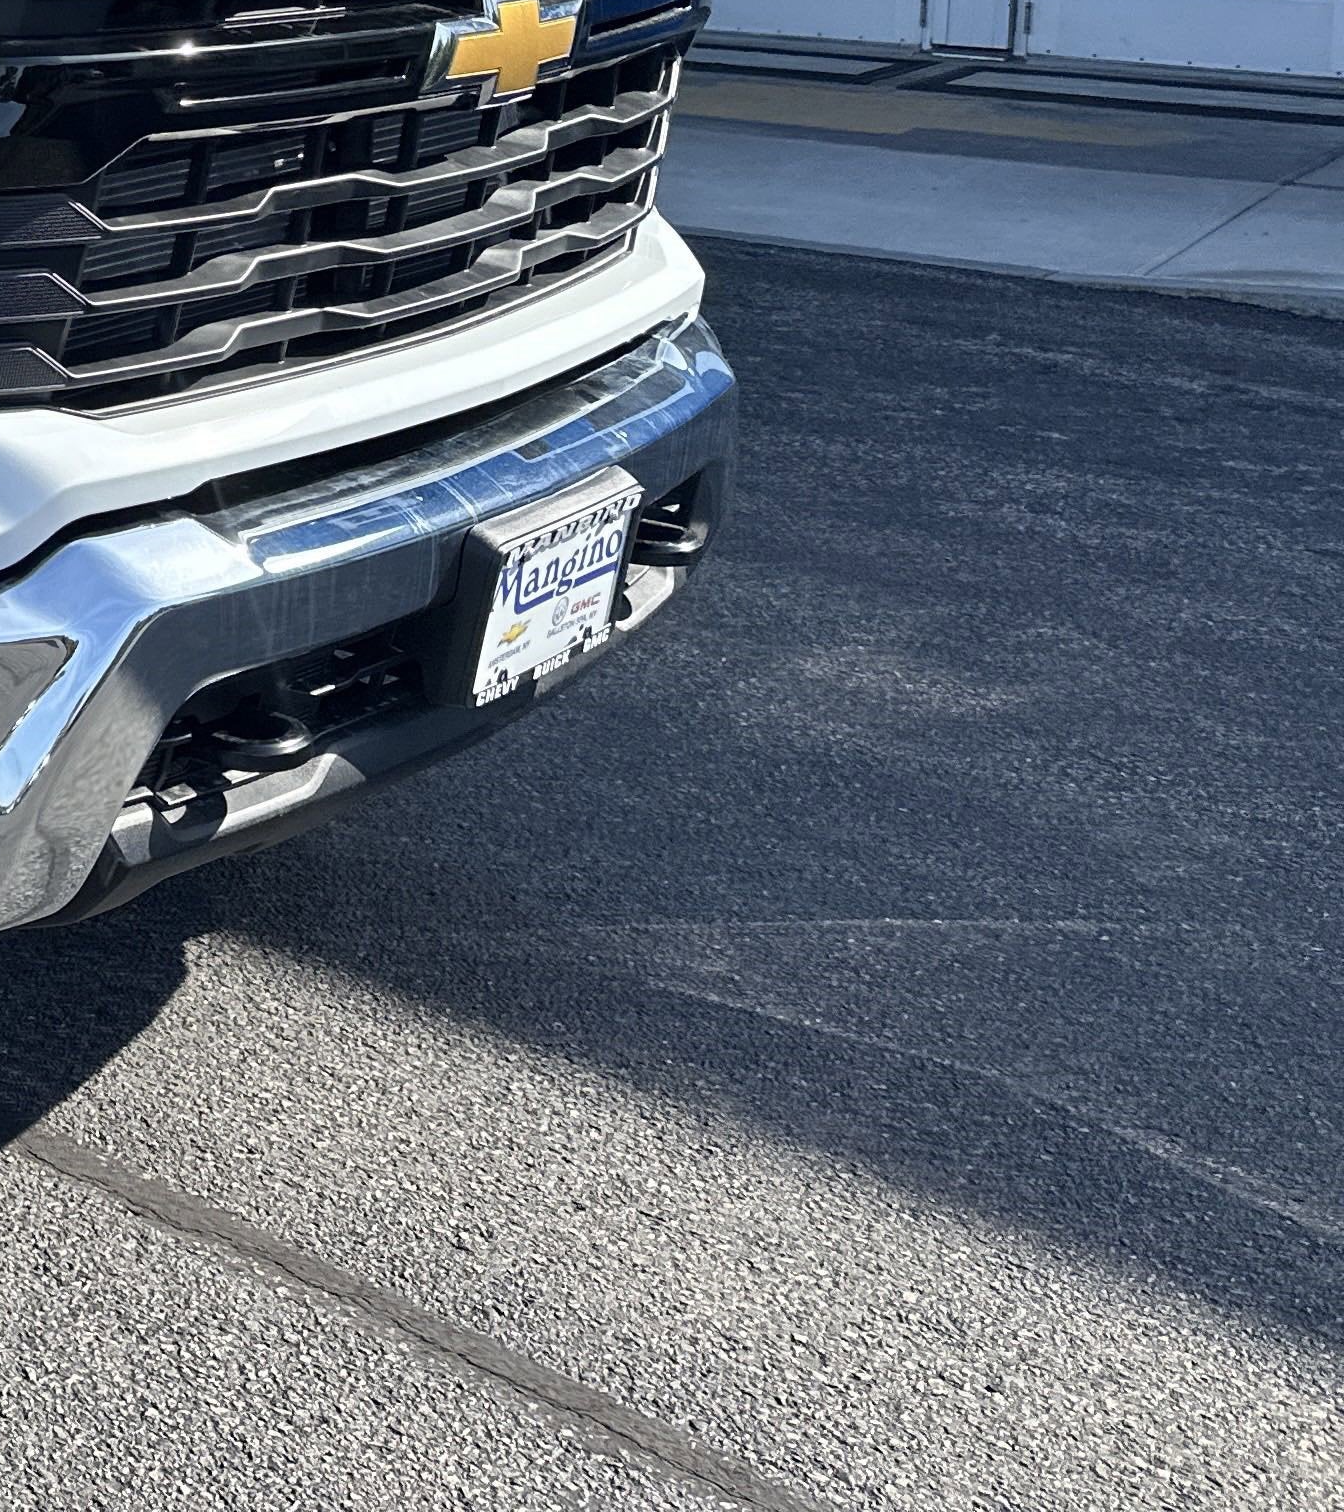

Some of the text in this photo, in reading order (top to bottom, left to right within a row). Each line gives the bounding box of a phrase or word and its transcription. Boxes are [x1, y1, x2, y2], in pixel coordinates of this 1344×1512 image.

[493, 528, 623, 615] Mangino
[570, 591, 602, 615] GMC
[475, 627, 611, 708] CHEVY BUICK GMC
